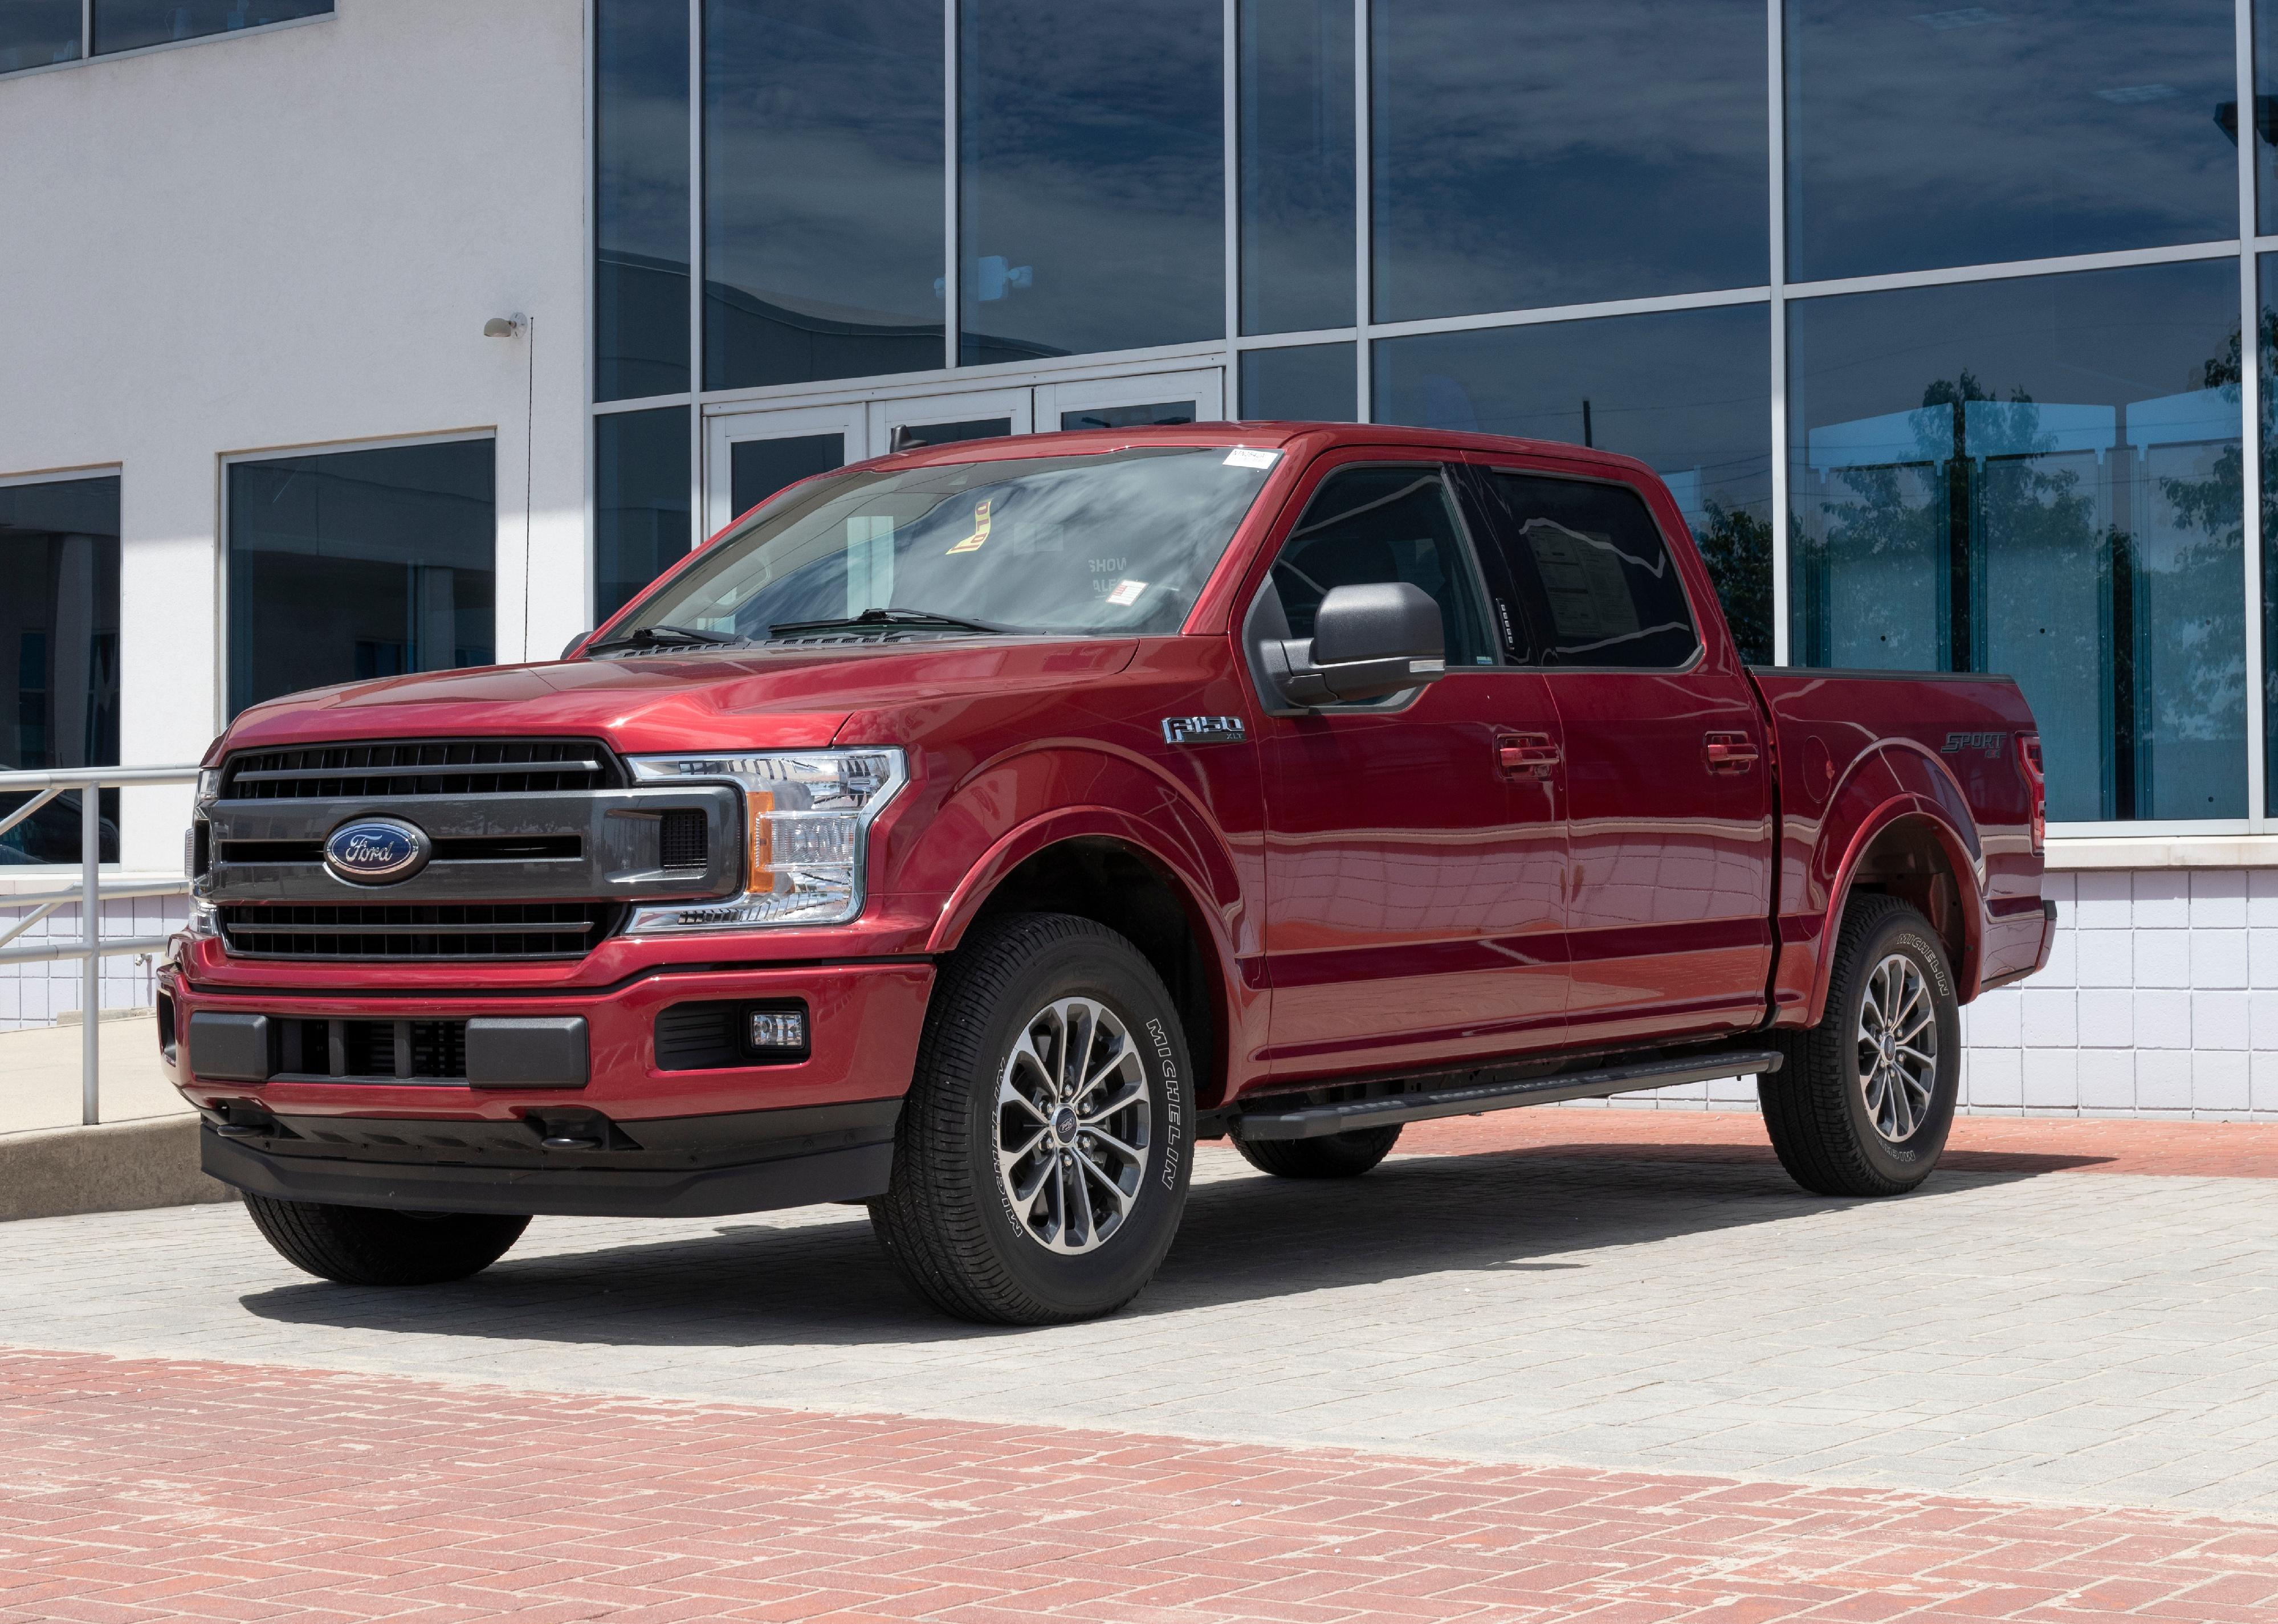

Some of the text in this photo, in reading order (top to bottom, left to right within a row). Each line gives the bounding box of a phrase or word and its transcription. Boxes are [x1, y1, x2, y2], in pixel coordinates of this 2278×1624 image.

[1940, 732, 2007, 753] SPORT
[345, 834, 394, 862] Ford
[1897, 933, 1950, 997] MICHELIN
[1146, 1017, 1181, 1190] MICHELIN
